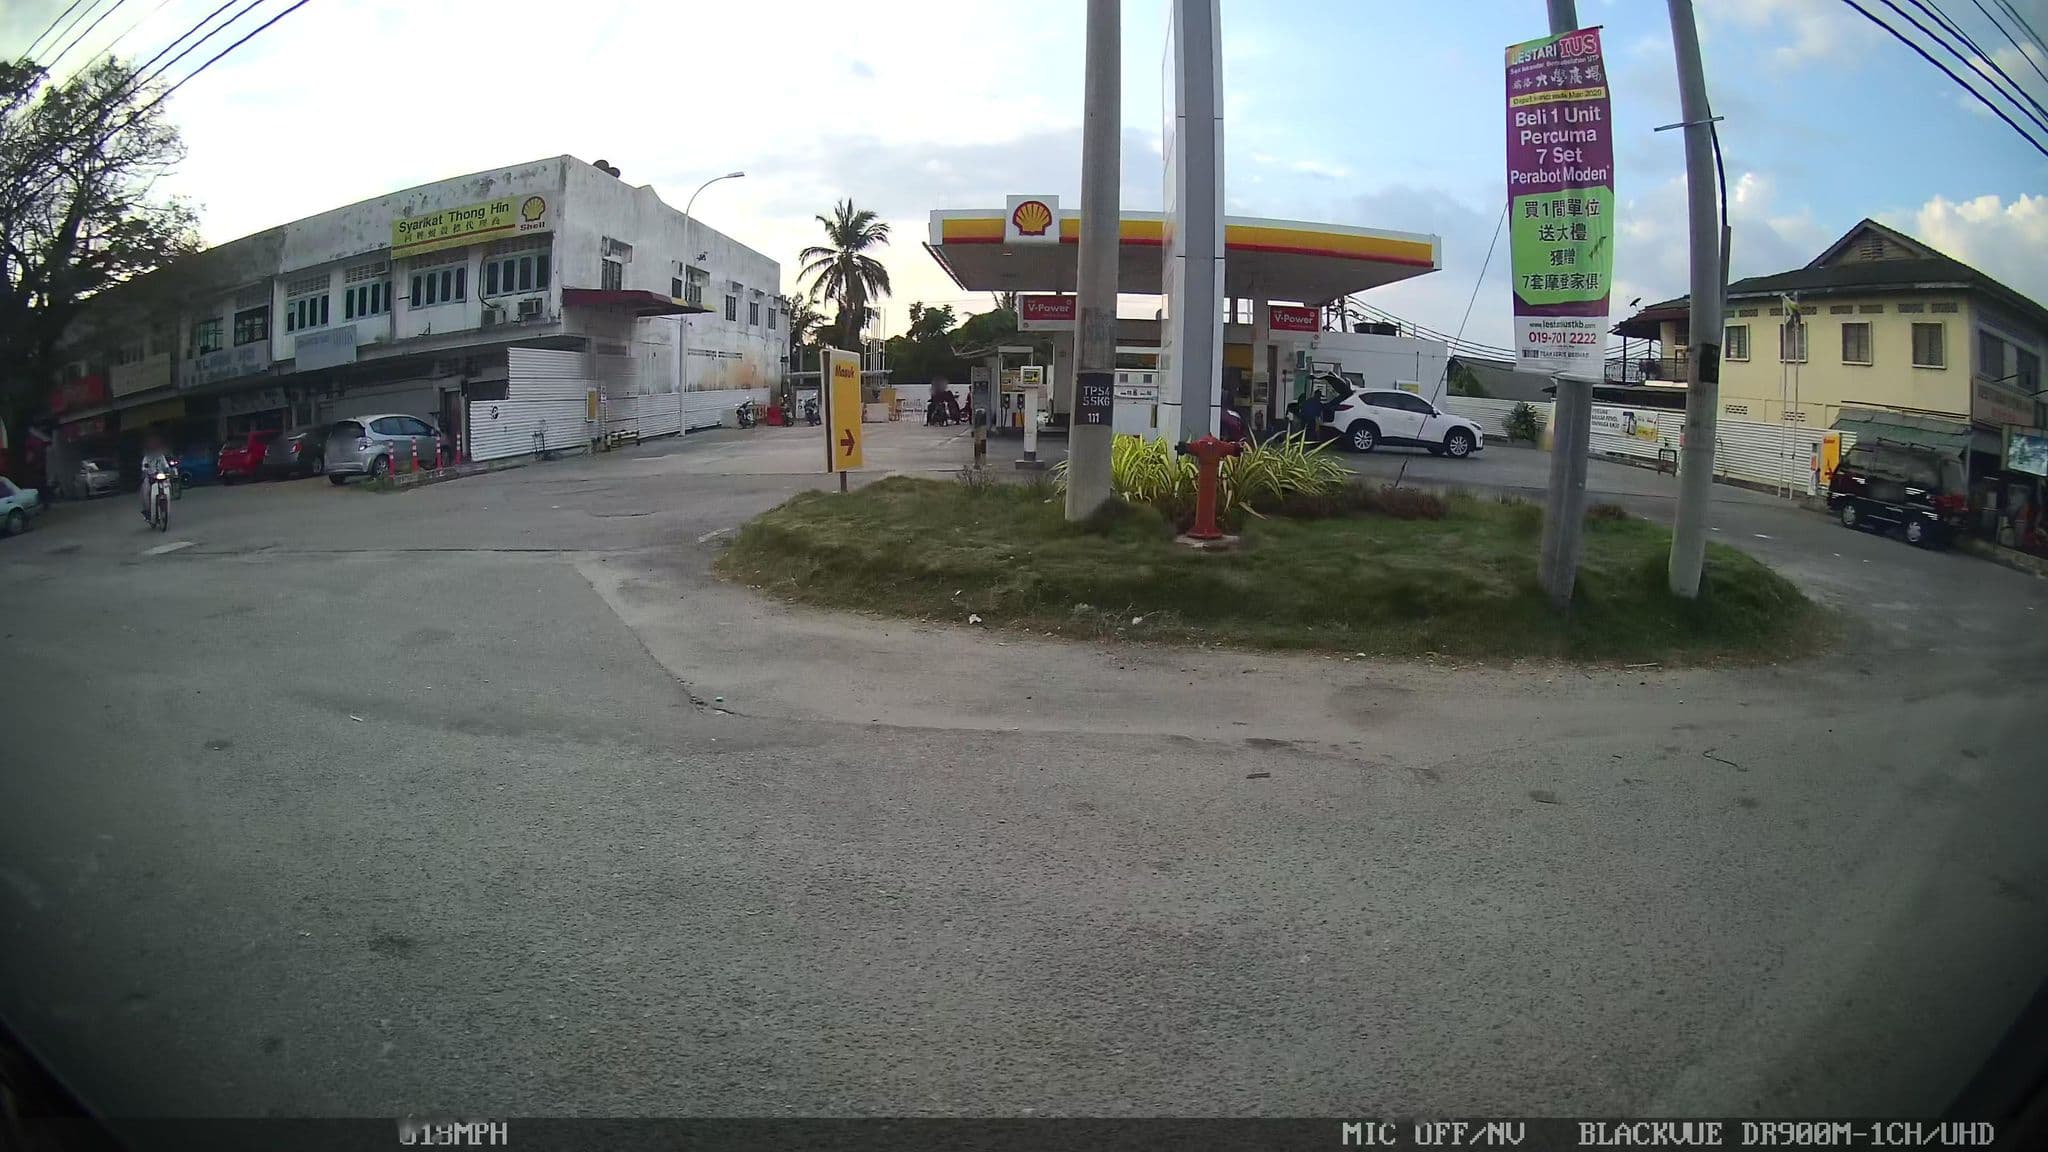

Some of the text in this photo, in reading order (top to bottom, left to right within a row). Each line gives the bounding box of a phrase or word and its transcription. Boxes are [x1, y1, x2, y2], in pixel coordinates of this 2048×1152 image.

[1512, 34, 1597, 65] LESTARI IUS
[1515, 106, 1601, 127] Beli 1 Unit
[1520, 129, 1597, 146] Percuma
[1536, 146, 1583, 164] 7 Set
[1510, 168, 1561, 184] Perabot
[1525, 198, 1600, 218] 買1間單位
[399, 202, 509, 234] Syarikat Thong Hin
[520, 221, 545, 232] Shell
[1538, 223, 1587, 241] 送大禮
[1529, 332, 1597, 345] 019-701 2222
[835, 364, 855, 378] Masuk
